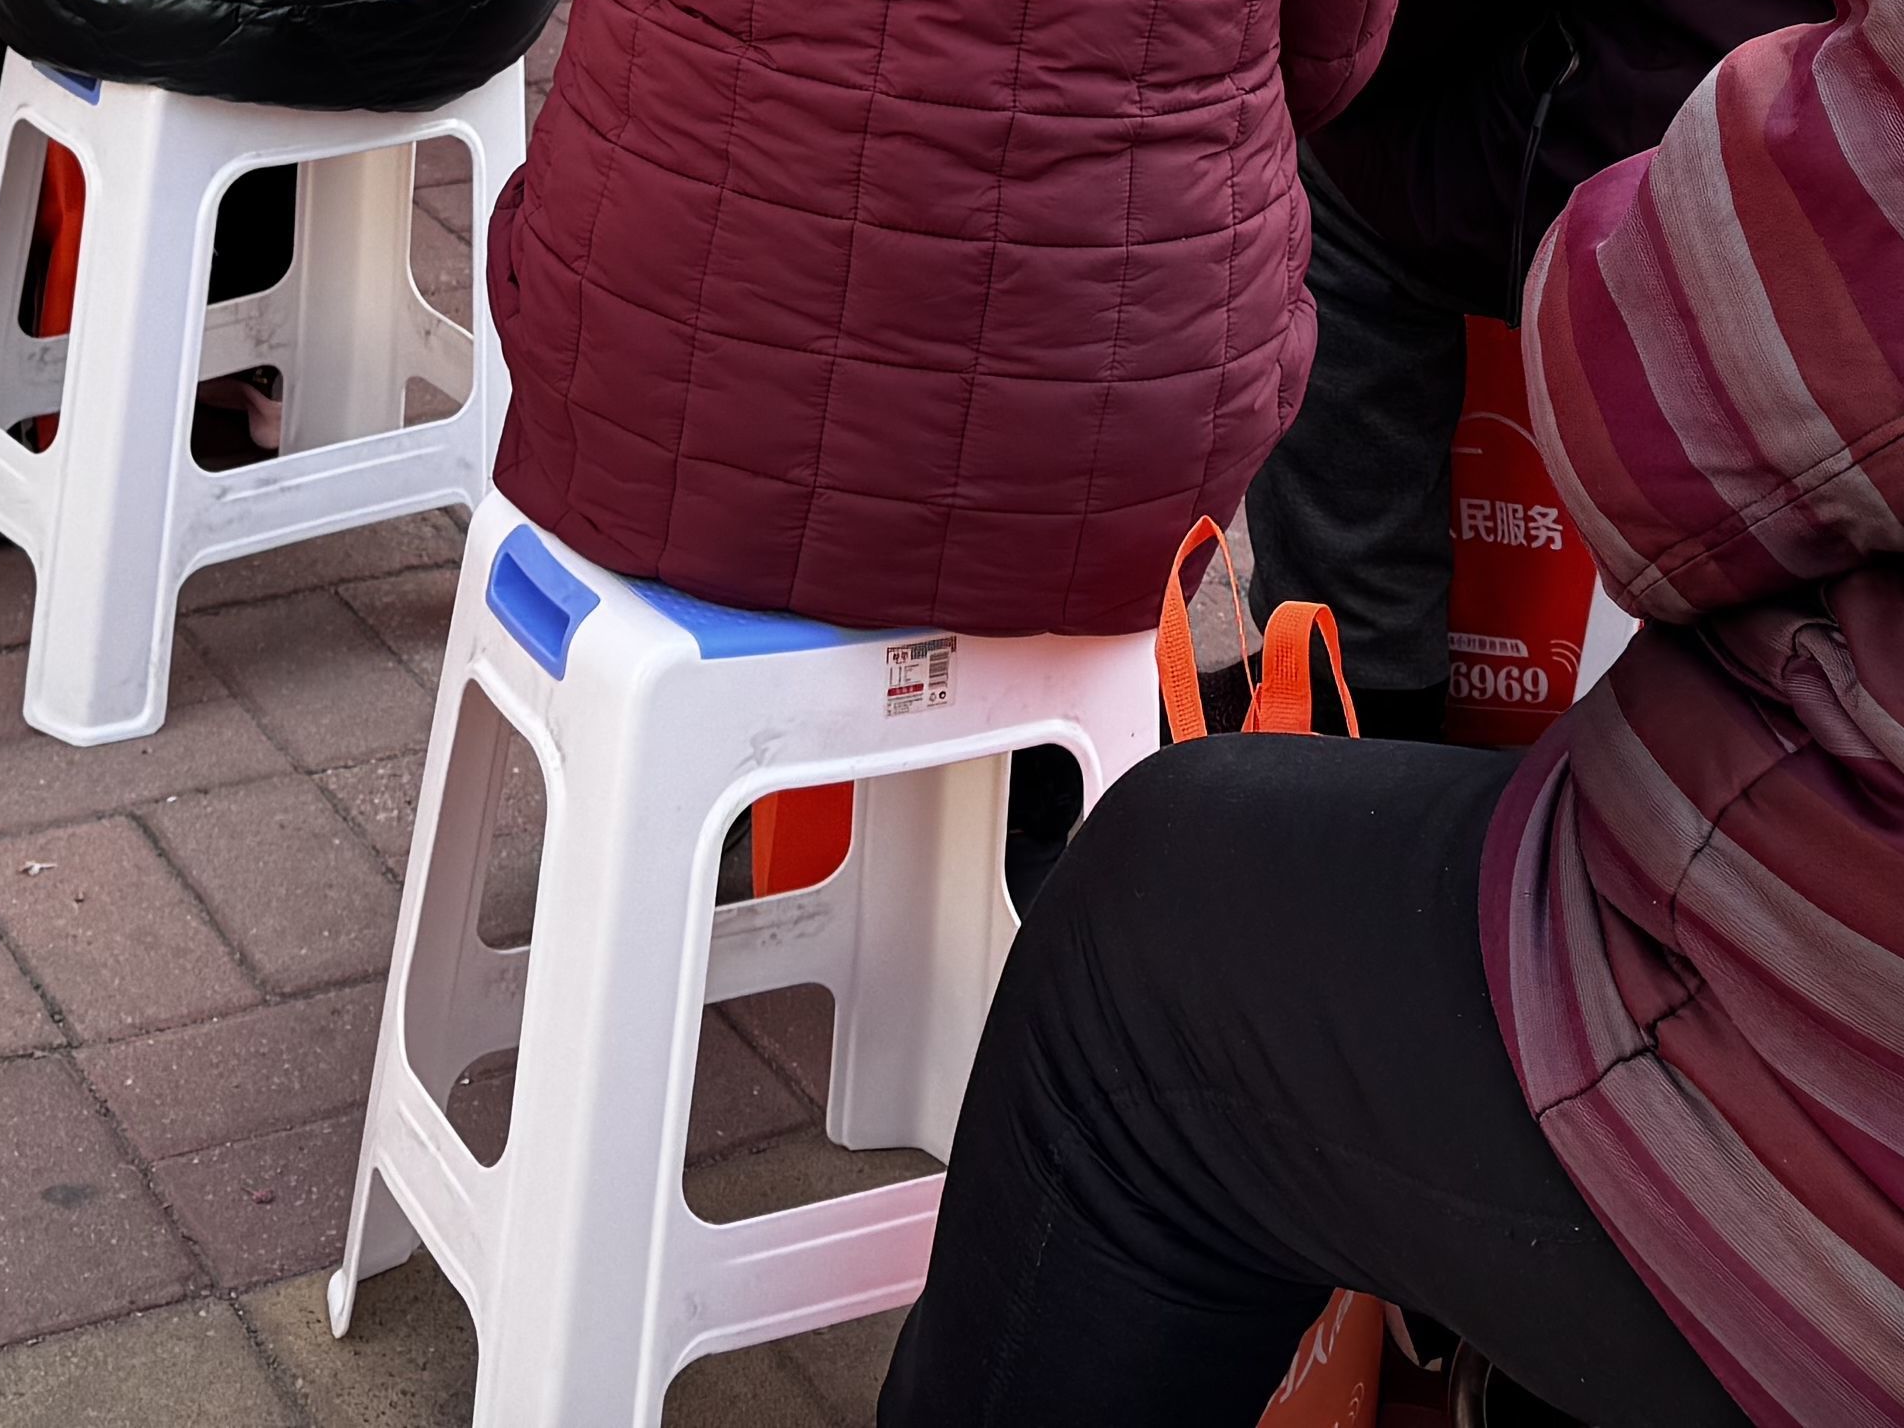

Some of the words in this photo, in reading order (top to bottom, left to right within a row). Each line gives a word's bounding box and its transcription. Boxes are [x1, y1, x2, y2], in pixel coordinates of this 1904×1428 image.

[1449, 497, 1564, 551] 民服务
[1449, 661, 1550, 704] 6969
